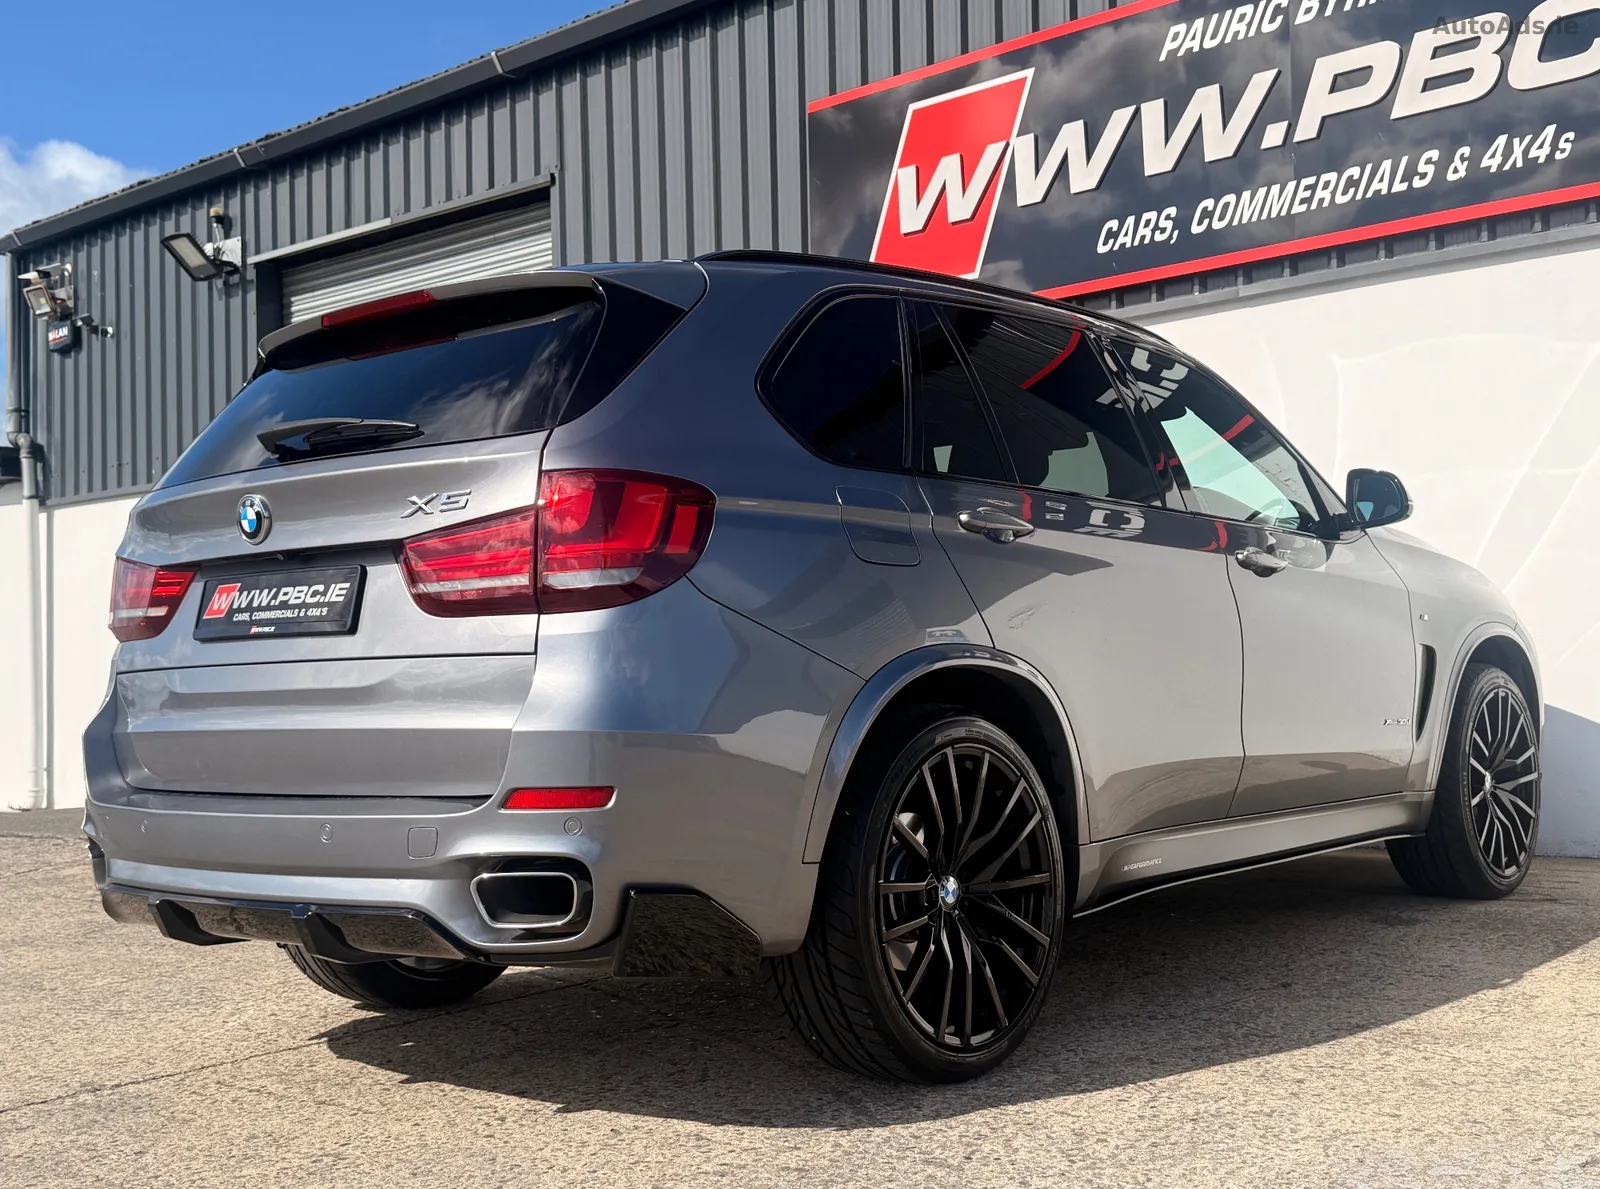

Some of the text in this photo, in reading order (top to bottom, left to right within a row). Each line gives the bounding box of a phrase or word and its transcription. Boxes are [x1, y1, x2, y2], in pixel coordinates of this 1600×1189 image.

[1159, 0, 1289, 62] PAURIC
[1097, 207, 1179, 254] CARS,
[1190, 150, 1440, 235] COMMERCIALS
[1446, 146, 1471, 182] &
[400, 488, 472, 519] X5
[212, 582, 351, 611] WWW.PBC.IE
[233, 612, 250, 622] CARS,
[252, 608, 298, 620] COMMERCIALS
